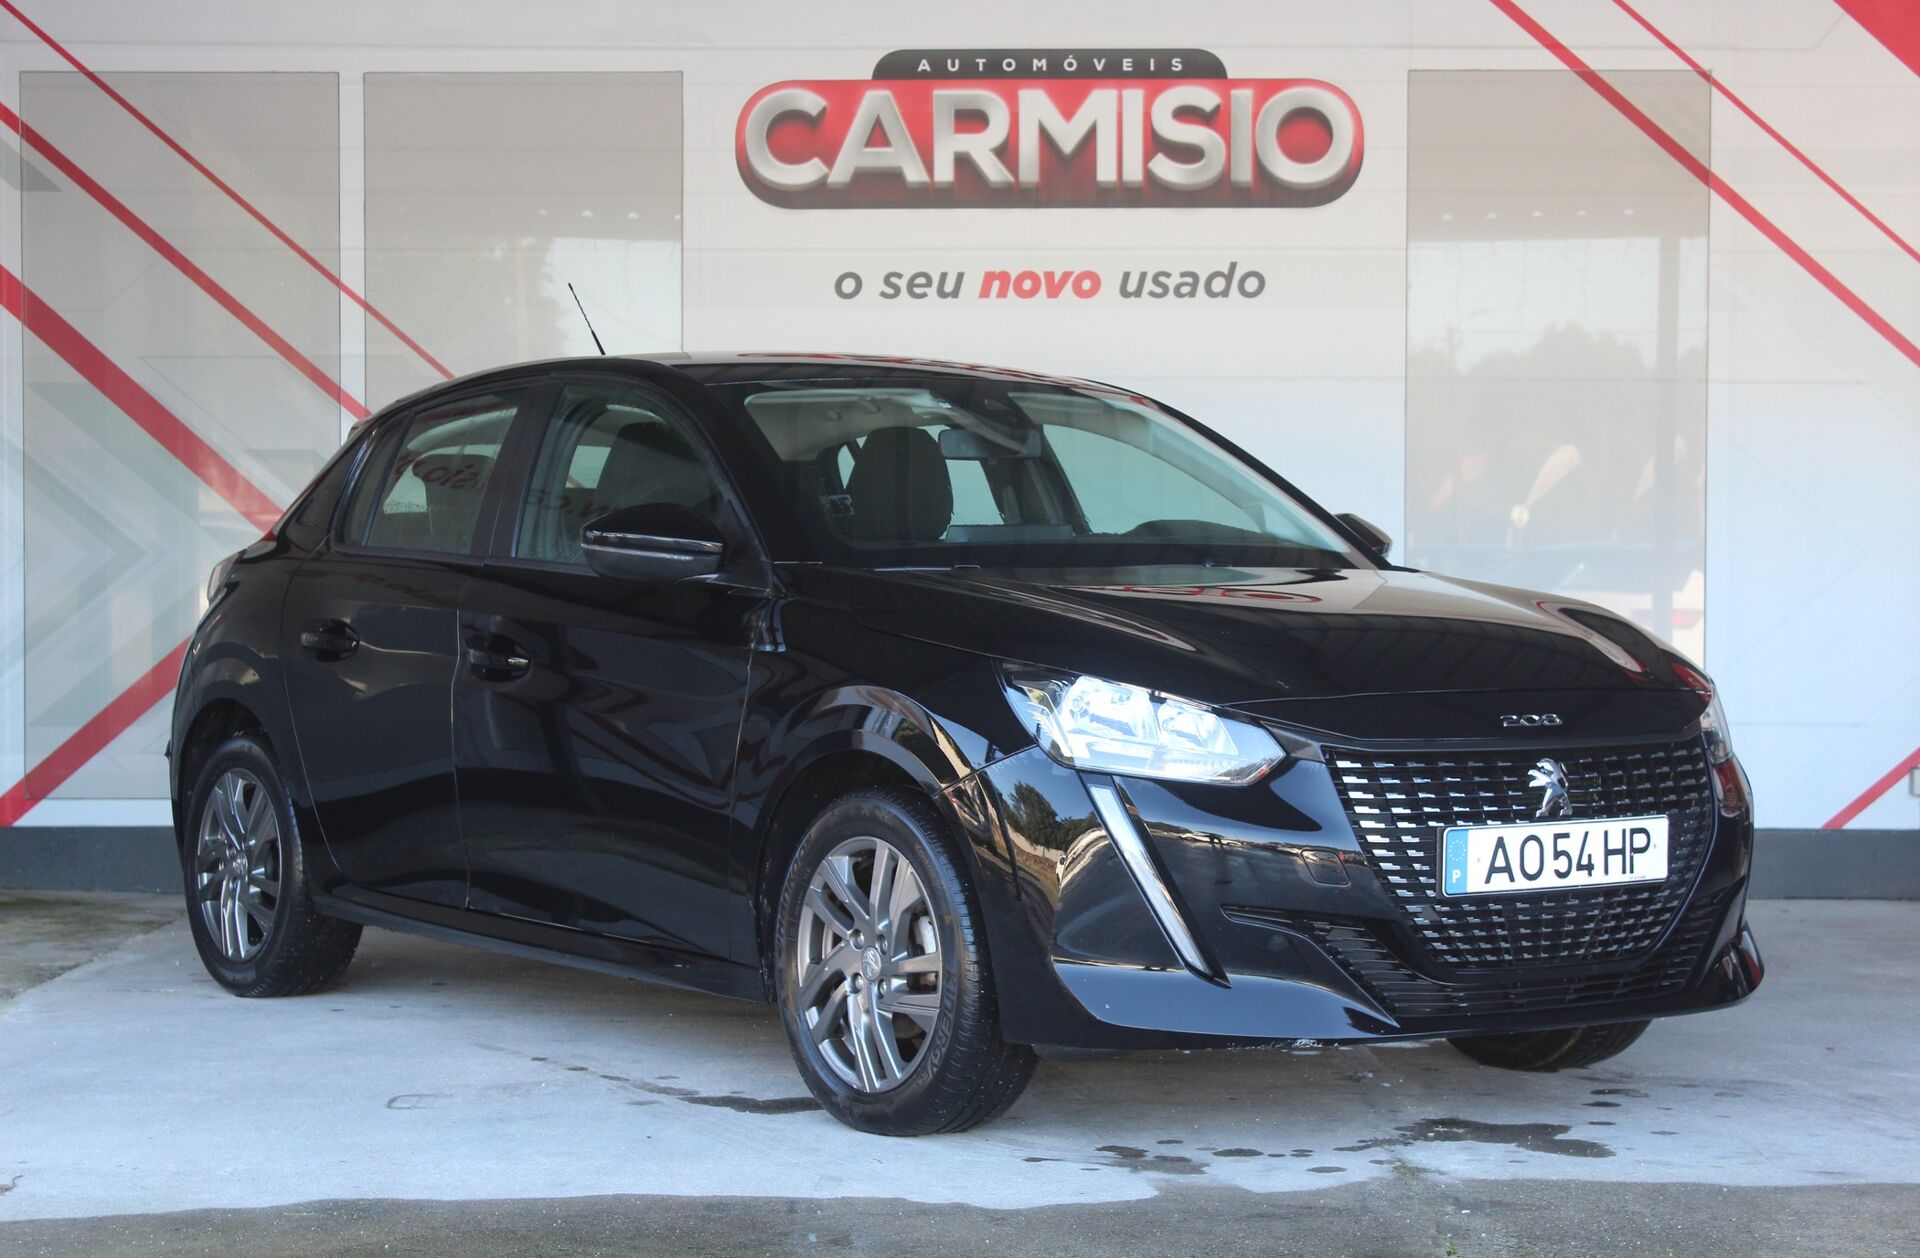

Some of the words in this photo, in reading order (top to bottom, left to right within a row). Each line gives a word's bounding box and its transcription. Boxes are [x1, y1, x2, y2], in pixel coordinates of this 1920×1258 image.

[916, 55, 1183, 72] AUTOMÓVEIS
[745, 85, 1354, 191] CARMISIO
[834, 271, 863, 299] o
[879, 271, 965, 299] seu
[978, 270, 1101, 299] novo
[1118, 261, 1267, 299] usado
[1500, 713, 1563, 727] 208
[1452, 869, 1461, 883] P
